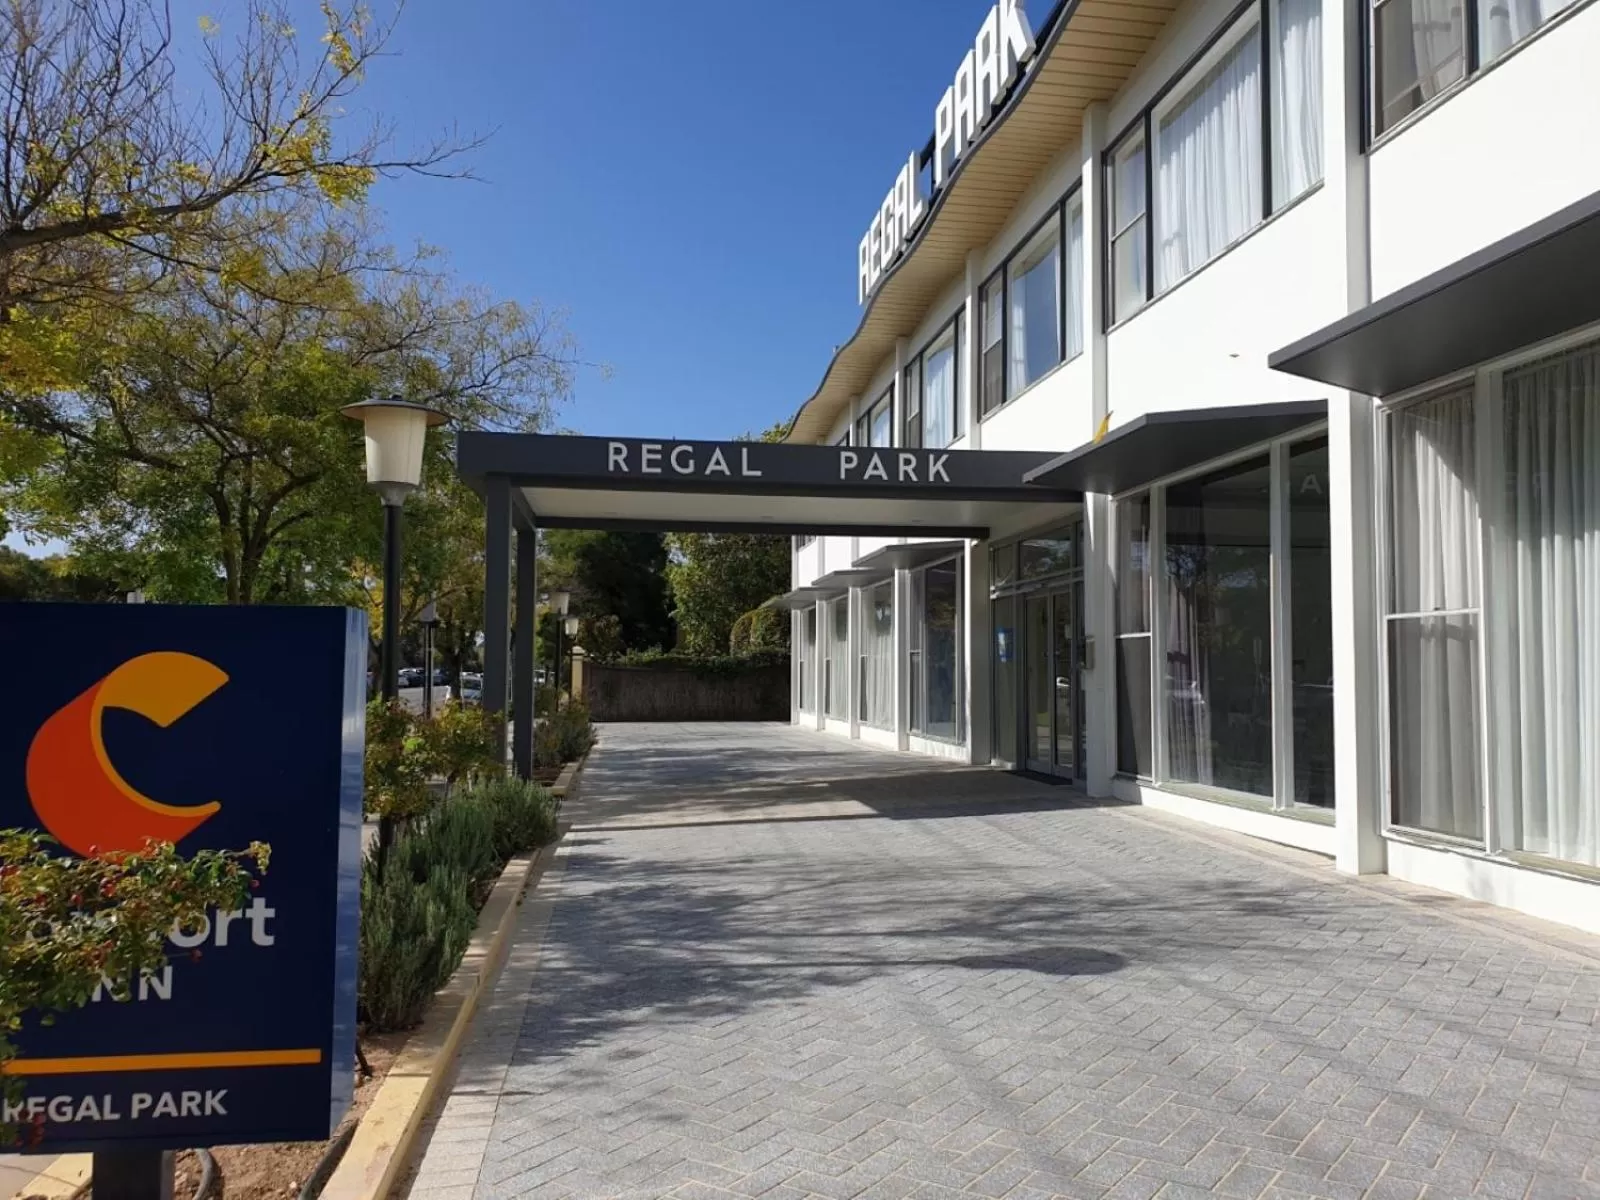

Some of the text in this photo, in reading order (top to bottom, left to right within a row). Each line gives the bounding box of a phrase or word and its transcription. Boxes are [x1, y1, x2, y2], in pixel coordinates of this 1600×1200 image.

[858, 0, 1037, 306] REGAL PARK
[607, 441, 951, 483] REGAL PARK
[130, 1089, 229, 1120] PARK
